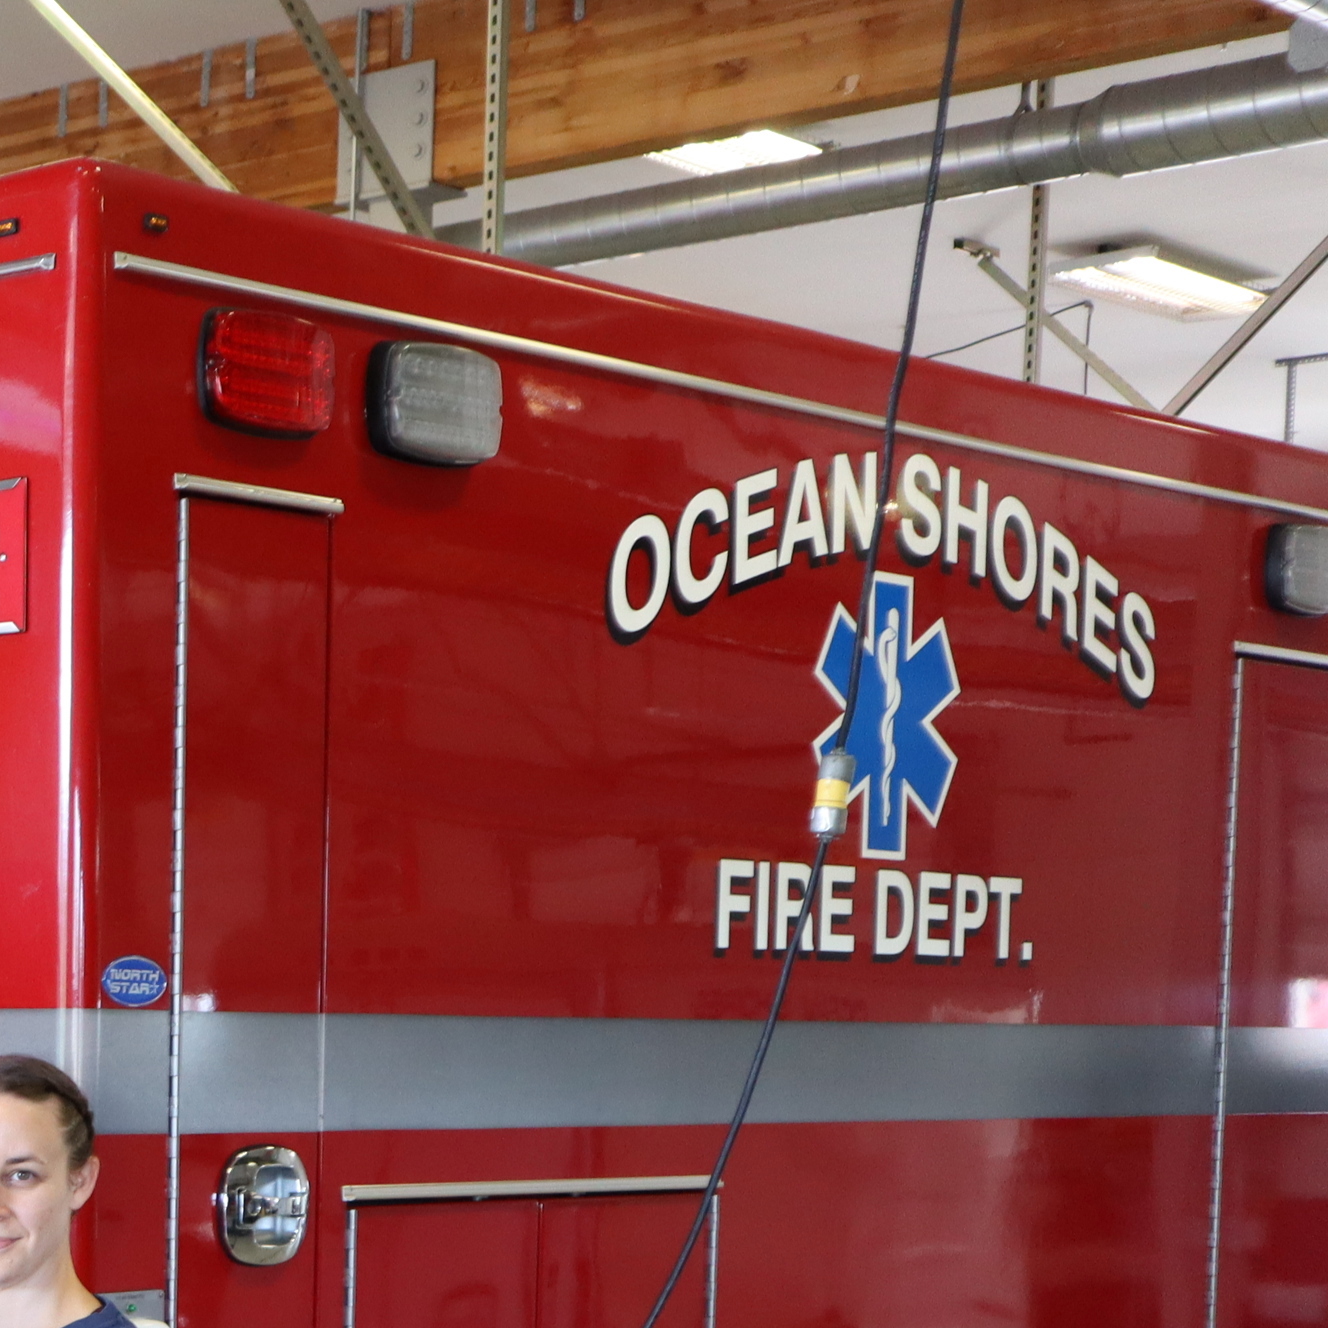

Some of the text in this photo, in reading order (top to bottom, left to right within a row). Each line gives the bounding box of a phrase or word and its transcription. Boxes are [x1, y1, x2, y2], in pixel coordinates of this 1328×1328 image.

[607, 450, 1157, 702] OCEAN SHORES
[713, 857, 1034, 962] FIRE DEPT.
[109, 981, 152, 995] STAR
[110, 968, 160, 982] NORTH
